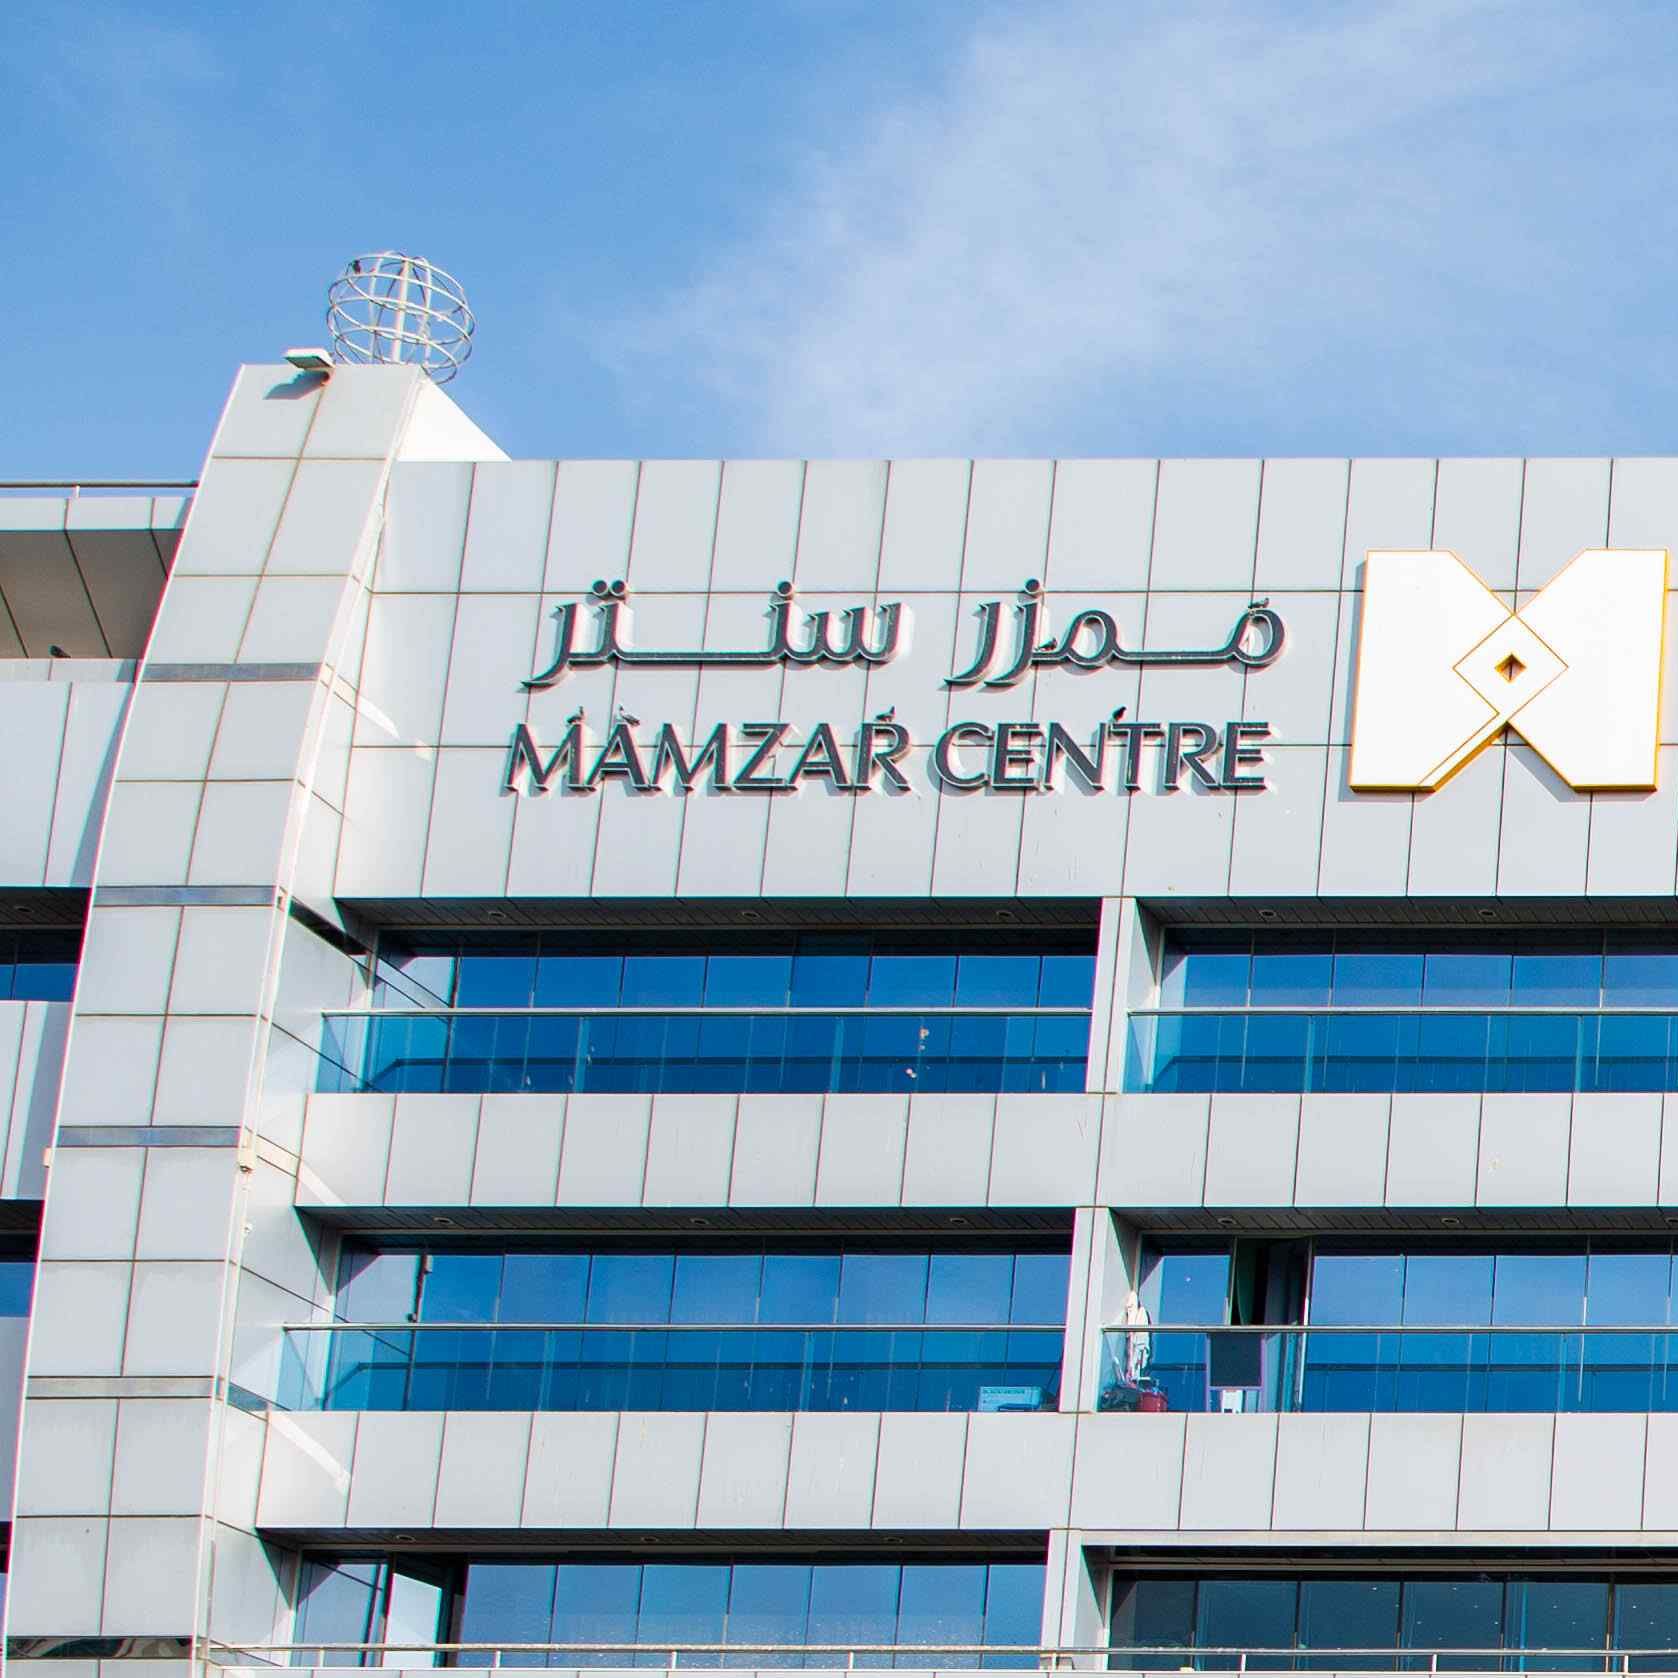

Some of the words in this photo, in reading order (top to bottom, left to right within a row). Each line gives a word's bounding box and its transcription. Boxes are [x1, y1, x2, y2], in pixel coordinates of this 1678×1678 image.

[521, 579, 900, 690] سنتر
[945, 579, 1286, 690] ممزر
[506, 721, 908, 794] MAMZAR
[935, 721, 1271, 793] CENTRE
